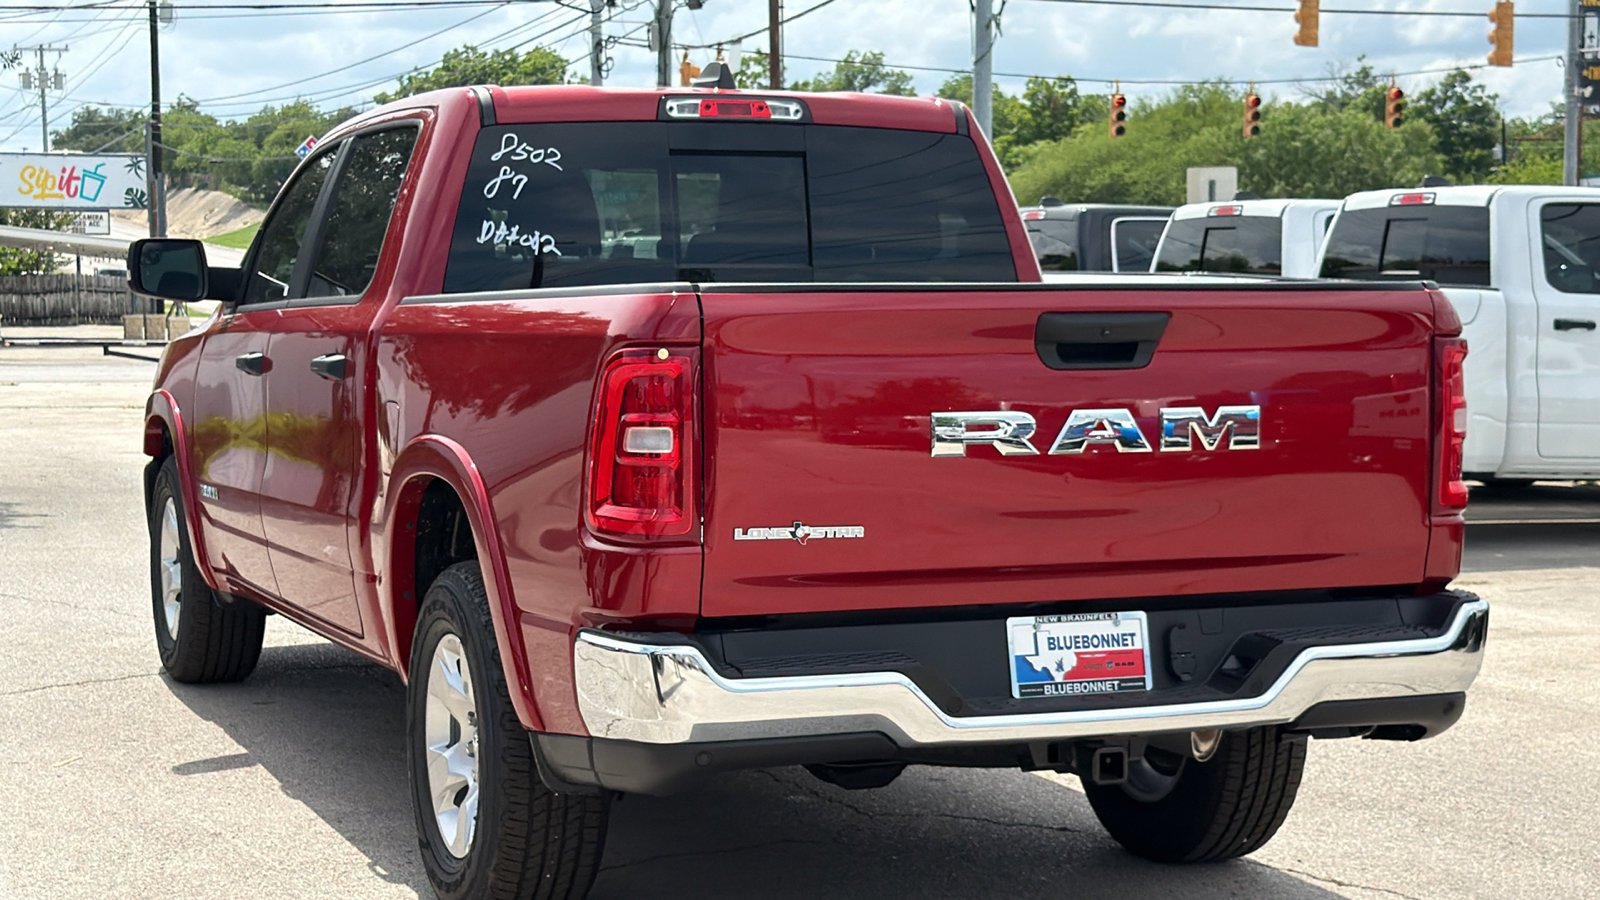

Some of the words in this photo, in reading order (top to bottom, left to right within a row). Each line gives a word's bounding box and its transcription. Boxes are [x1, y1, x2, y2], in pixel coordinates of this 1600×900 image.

[930, 405, 1262, 458] RAM
[734, 527, 790, 541] LONE
[810, 526, 865, 539] STAR
[1036, 615, 1058, 624] NEW
[1060, 612, 1118, 622] BRAUNFELS
[1047, 632, 1136, 651] BLUEBONNET
[1044, 681, 1120, 695] BLUEBONNET
